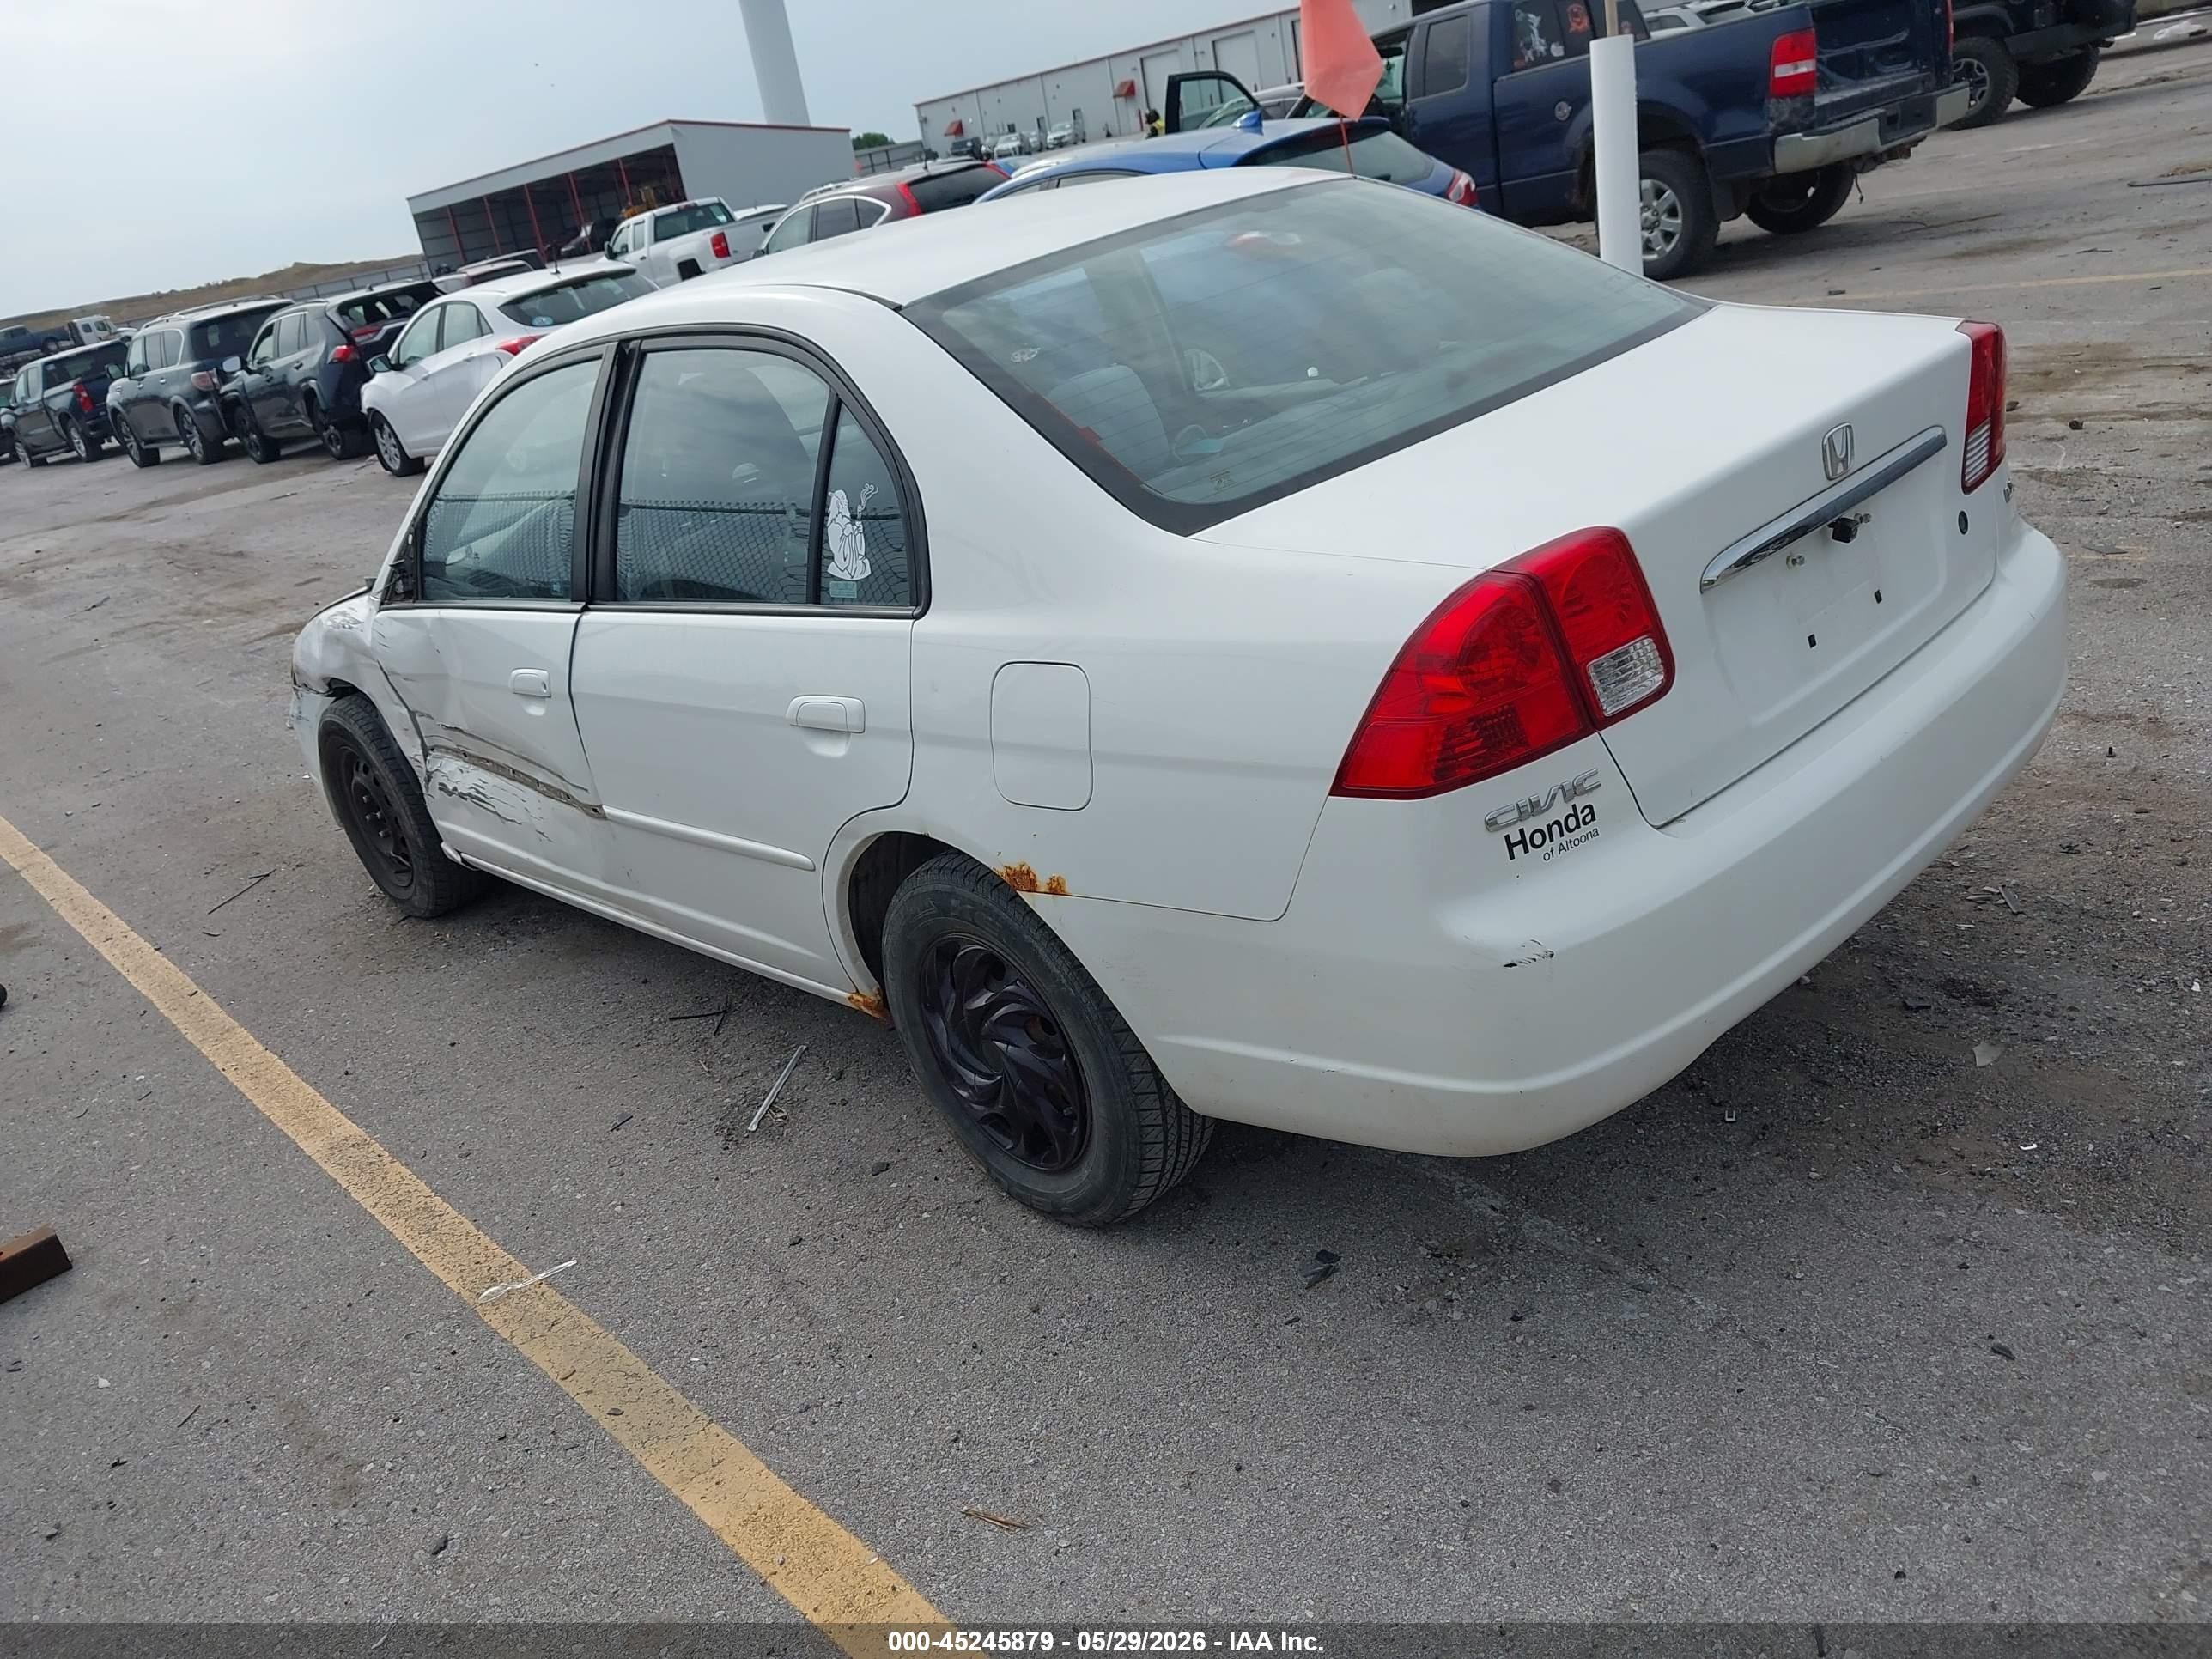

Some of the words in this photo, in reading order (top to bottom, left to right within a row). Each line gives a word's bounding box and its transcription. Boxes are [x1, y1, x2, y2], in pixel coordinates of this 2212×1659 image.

[1485, 769, 1601, 832] CIVIC
[1504, 803, 1596, 860] Honda
[1542, 848, 1555, 862] of
[1558, 827, 1600, 856] Altoona
